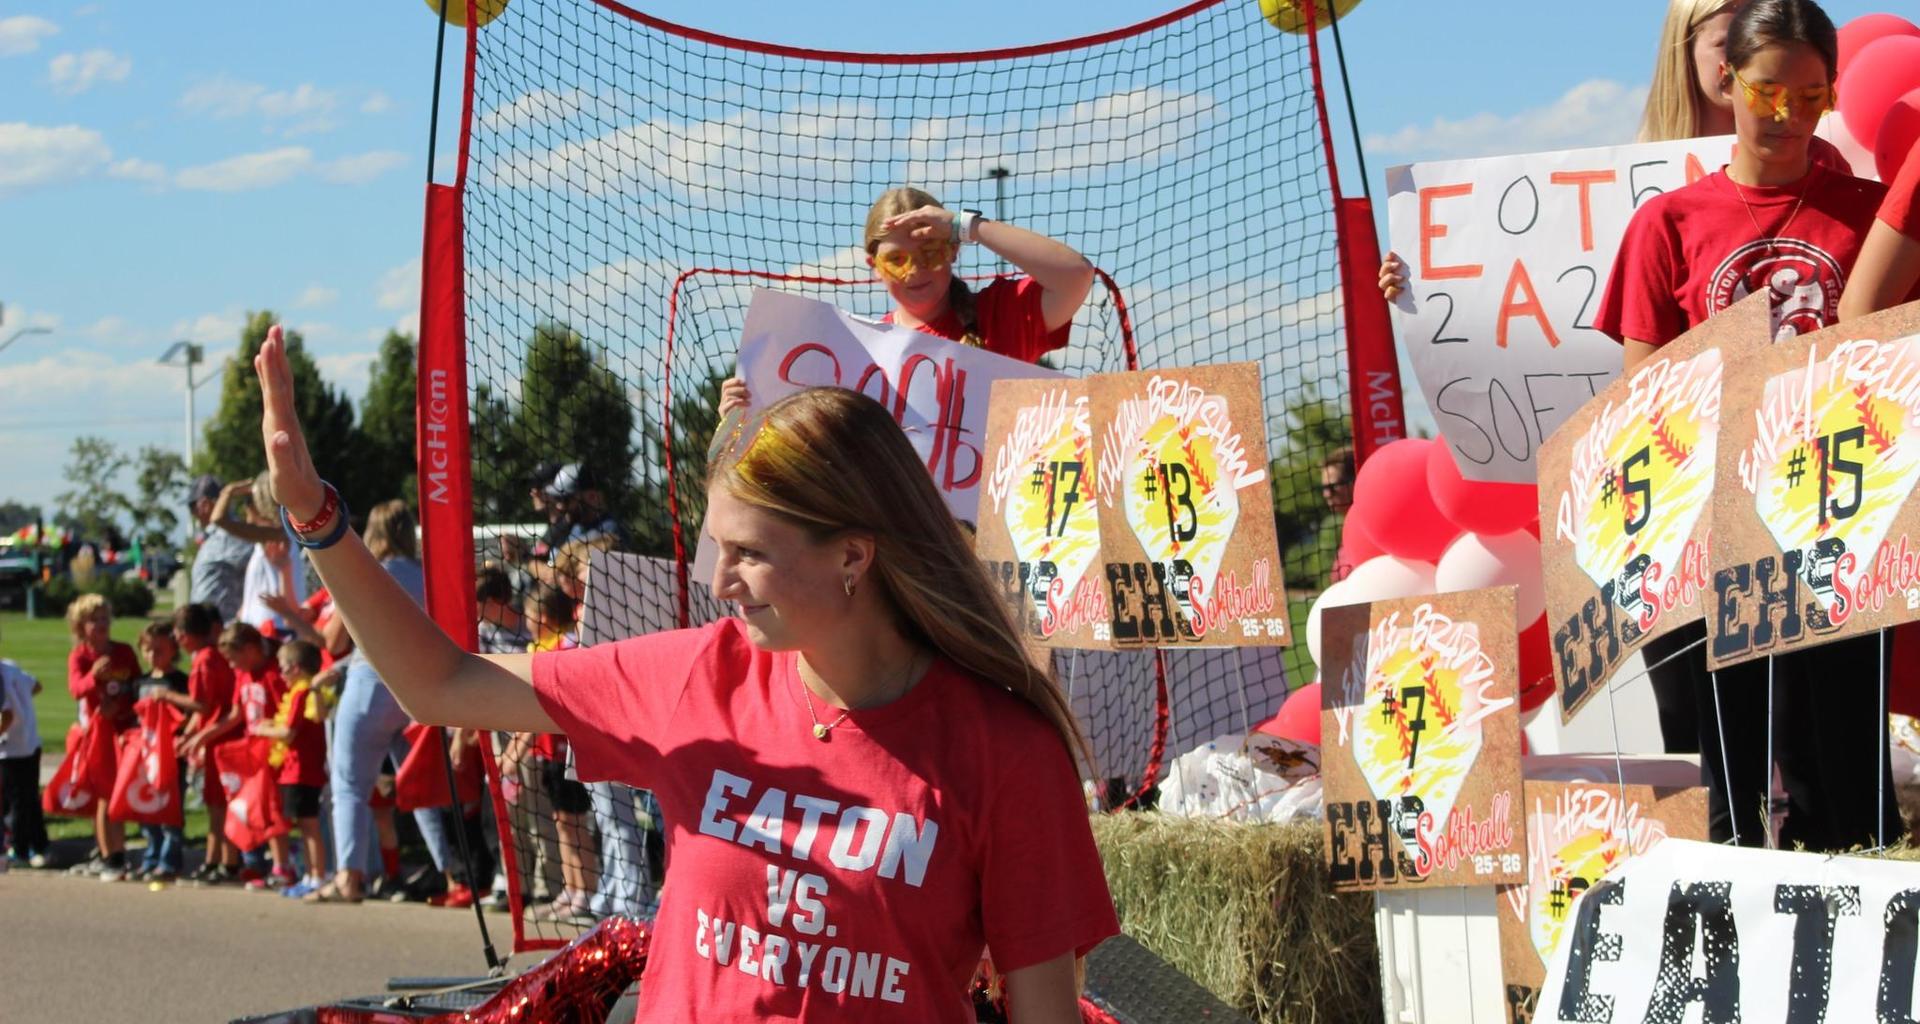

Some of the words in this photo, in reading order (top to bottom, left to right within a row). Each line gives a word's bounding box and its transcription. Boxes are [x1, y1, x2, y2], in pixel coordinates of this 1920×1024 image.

[1716, 268, 1739, 314] ATON
[427, 369, 449, 504] McHom
[988, 389, 1068, 515] ISABELLA
[1147, 375, 1265, 490] BRADSHAW
[1738, 343, 1820, 494] EMILY
[1032, 461, 1083, 538] #17
[1144, 463, 1197, 542] #13
[1602, 445, 1651, 535] #5
[1787, 426, 1864, 525] #15
[1106, 559, 1204, 643] EHS
[1188, 558, 1272, 637] Softball
[1239, 618, 1285, 637] '25-'26
[1554, 554, 1656, 711] EHS
[1713, 537, 1848, 661] EHS
[1382, 685, 1427, 769] #7
[699, 769, 939, 888] EATON
[1327, 796, 1428, 883] EHS
[1415, 791, 1512, 877] Softball
[1471, 854, 1521, 874] '25-'26
[766, 864, 837, 937] VS.
[695, 908, 910, 1004] EVERYONE
